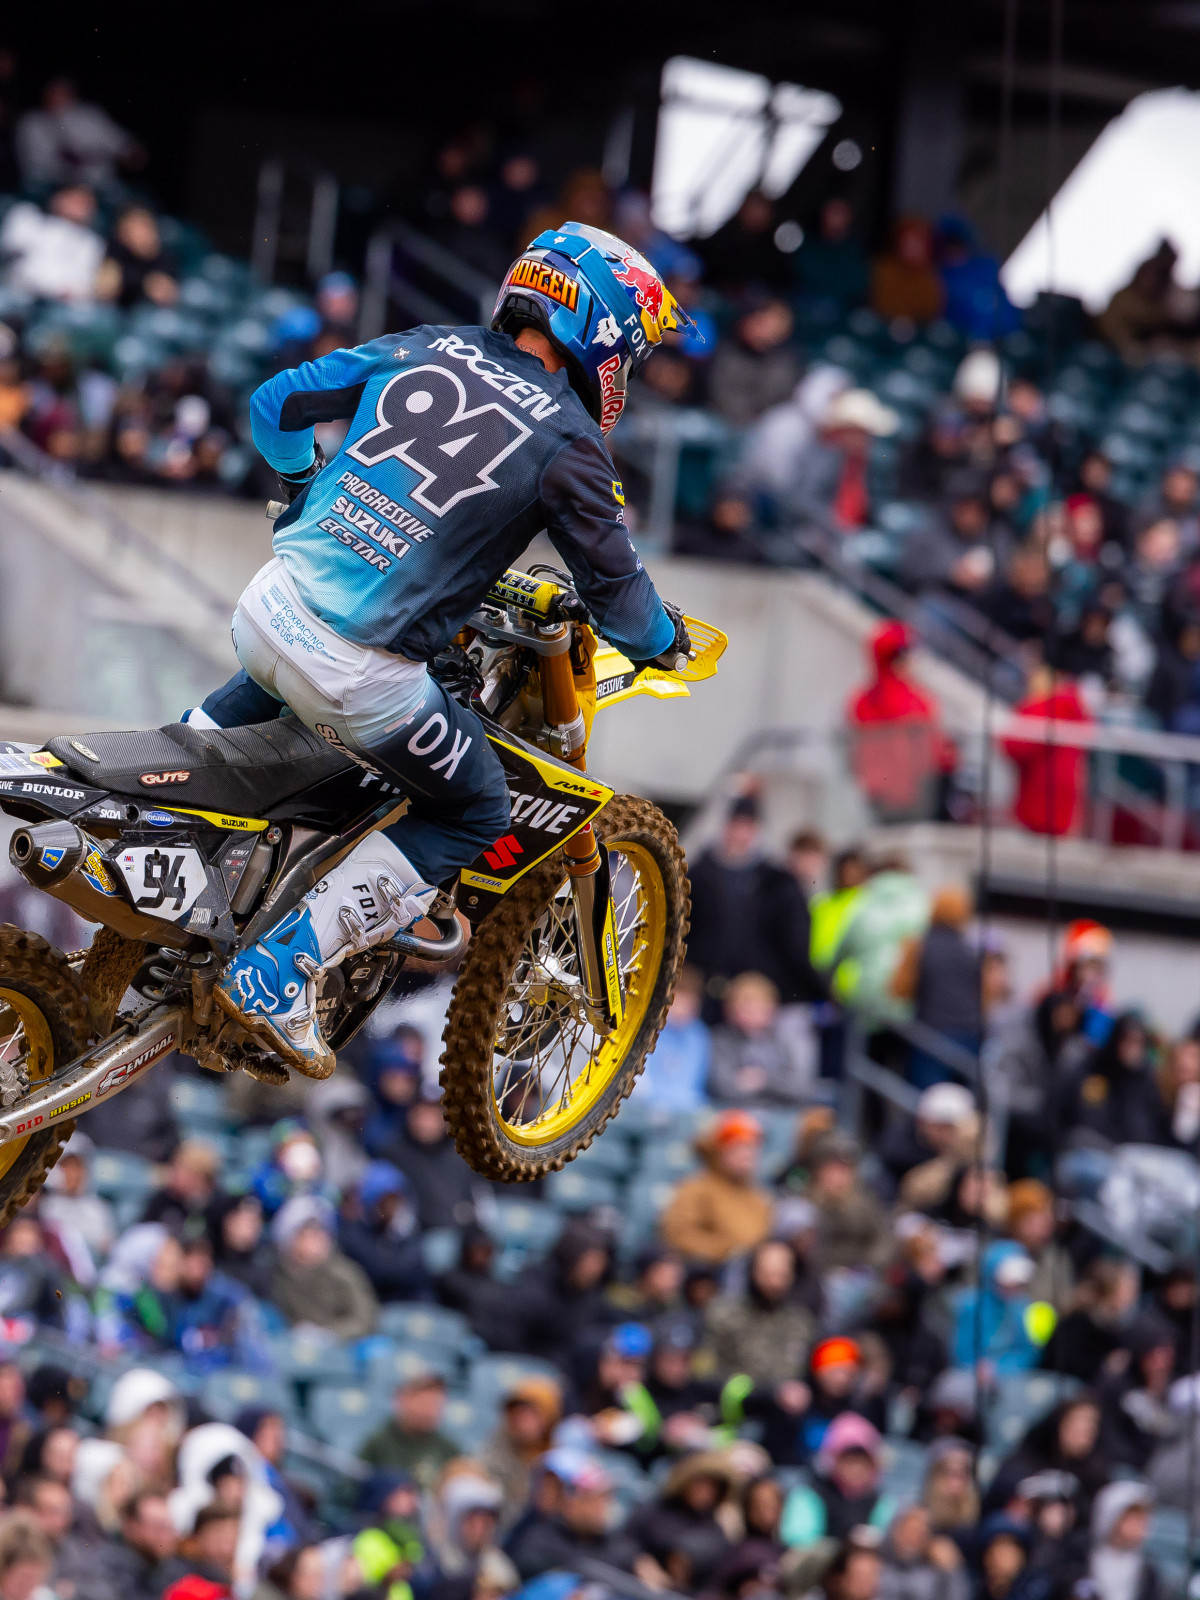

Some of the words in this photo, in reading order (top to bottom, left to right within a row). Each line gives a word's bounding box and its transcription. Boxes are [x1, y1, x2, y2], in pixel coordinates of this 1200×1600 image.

[623, 312, 647, 358] FOX
[427, 334, 562, 422] ROCZEN
[597, 354, 626, 400] Red
[601, 398, 625, 433] Bu
[345, 364, 534, 518] 94
[330, 495, 412, 560] SUZUKI
[335, 471, 436, 543] PROGRESSIVE
[317, 517, 392, 575] ECSTAR
[282, 604, 325, 650] FOXRACING
[22, 782, 85, 800] DUNLOP
[140, 770, 191, 785] GUTS
[552, 780, 603, 798] RM-Z
[221, 818, 249, 828] SUZUKI
[87, 855, 114, 893] CIRCUIT
[135, 853, 187, 911] 94
[469, 875, 503, 888] ECSTAR
[352, 883, 379, 922] FOX
[96, 1032, 177, 1098] RENTHAL
[49, 1091, 92, 1118] HINSON
